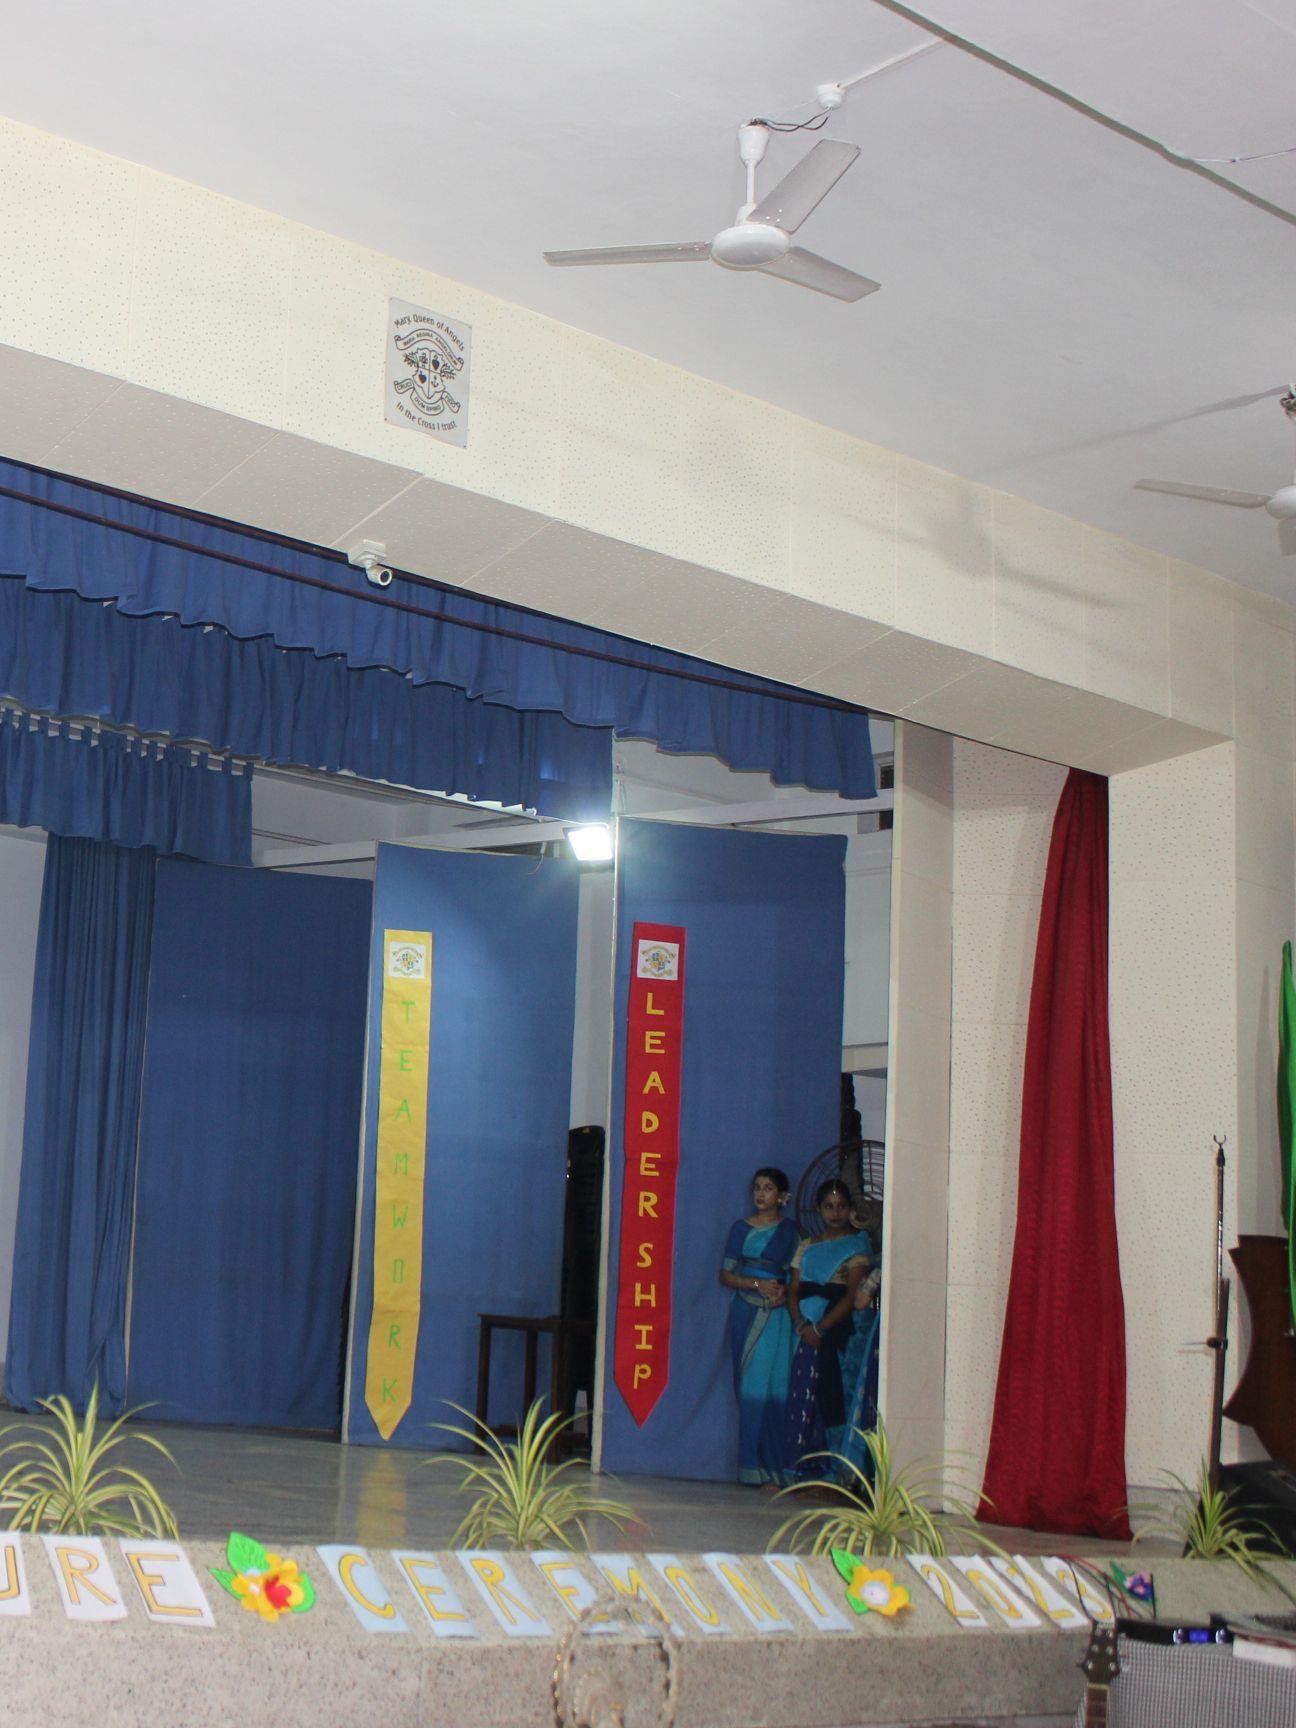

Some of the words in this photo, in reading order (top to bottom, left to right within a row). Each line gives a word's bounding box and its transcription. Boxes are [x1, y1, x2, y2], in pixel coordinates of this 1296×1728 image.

[394, 315, 412, 328] Mary
[412, 313, 435, 325] Queen
[436, 320, 444, 330] of
[444, 326, 465, 352] Angels
[395, 401, 405, 413] In
[404, 409, 417, 422] the
[417, 417, 436, 430] Cross
[441, 420, 457, 431] trust
[381, 1001, 416, 1402] TEAMWORK
[632, 992, 666, 1390] LEADERSHIP
[337, 1553, 828, 1626] CEREMONY
